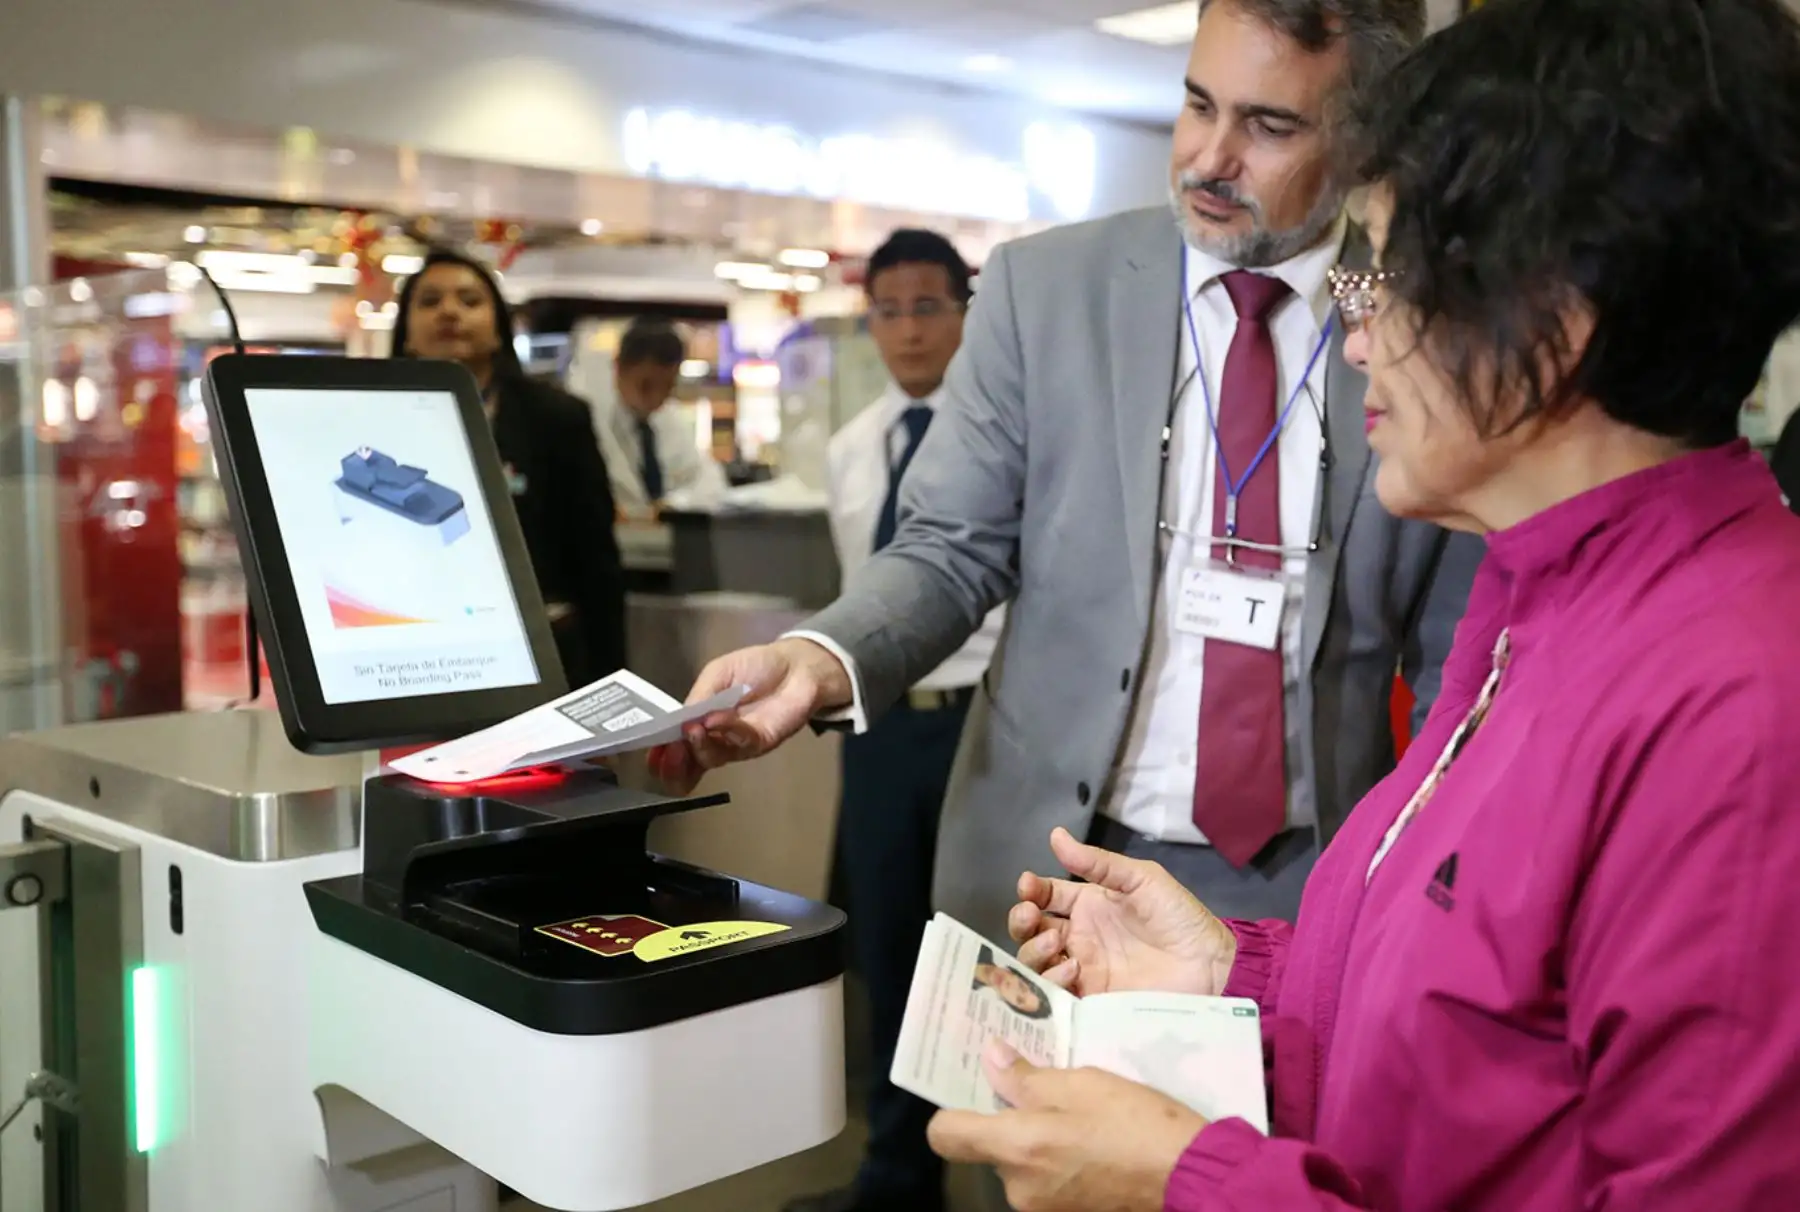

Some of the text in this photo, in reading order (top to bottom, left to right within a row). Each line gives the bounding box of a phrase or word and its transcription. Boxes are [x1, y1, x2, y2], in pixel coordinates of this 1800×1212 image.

[1245, 596, 1266, 624] T
[354, 655, 498, 677] Sin Tarjeta de Embarque
[378, 669, 482, 688] No Boarding Pass
[668, 930, 750, 952] PASSPORT
